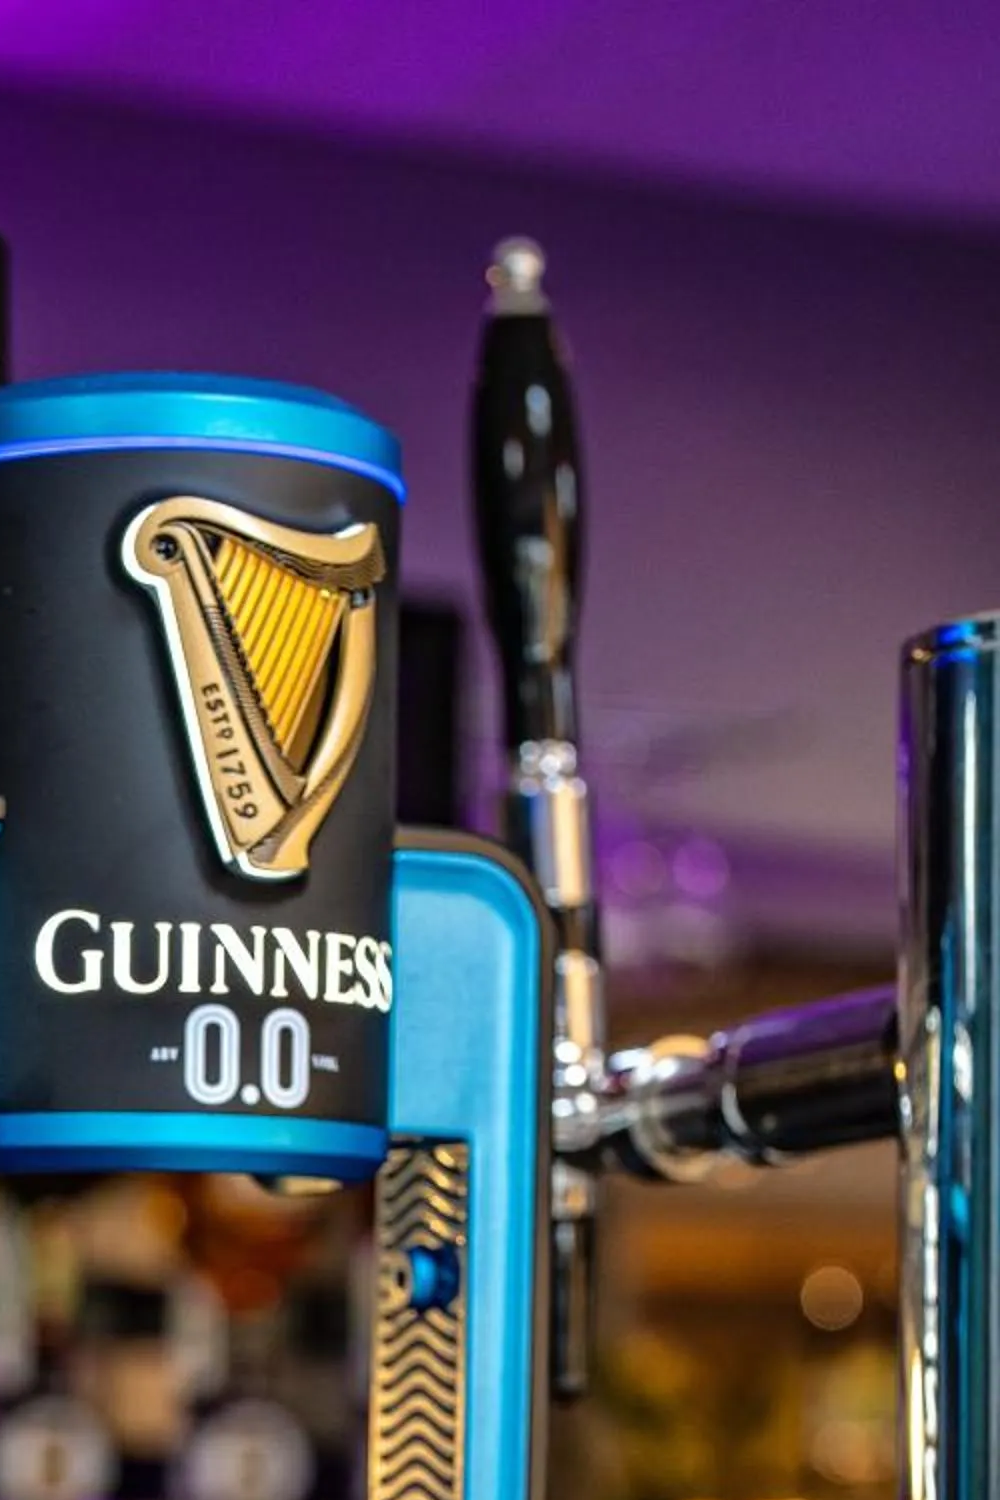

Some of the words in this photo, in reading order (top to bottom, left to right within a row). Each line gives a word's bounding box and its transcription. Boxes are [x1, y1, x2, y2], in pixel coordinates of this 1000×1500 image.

[216, 748, 259, 820] 1759
[35, 909, 393, 1013] GUINNESS
[184, 1004, 310, 1109] 0.0
